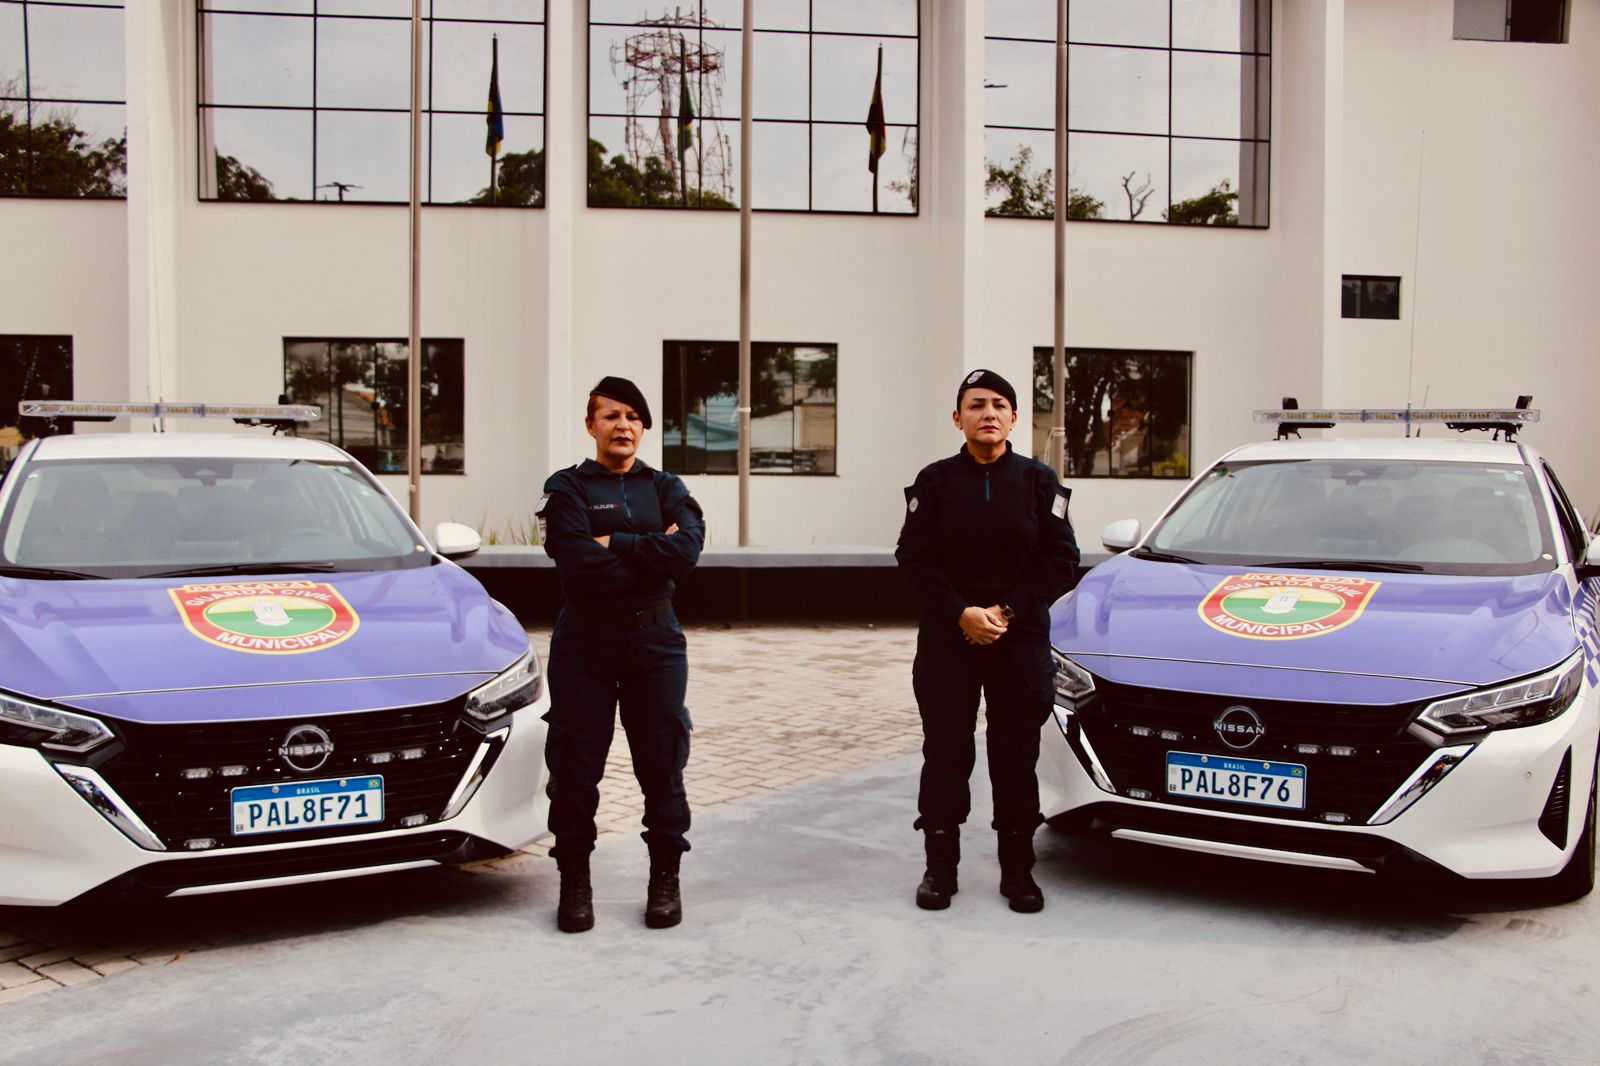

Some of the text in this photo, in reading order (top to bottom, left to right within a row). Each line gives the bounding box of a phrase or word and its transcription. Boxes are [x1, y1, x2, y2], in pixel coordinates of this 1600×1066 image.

[1223, 580, 1364, 597] GUARDA CIVIL
[186, 589, 332, 606] GUARDA CIVIL
[1211, 614, 1334, 635] MUNICIPAL
[216, 629, 346, 649] MUNICIPAL
[1213, 721, 1265, 735] NISSAN
[278, 743, 334, 756] NISSAN
[1223, 762, 1246, 770] BRASIL
[296, 787, 321, 795] BRASIL
[1180, 768, 1290, 802] PAL8F76
[248, 793, 368, 828] PAL8F71
